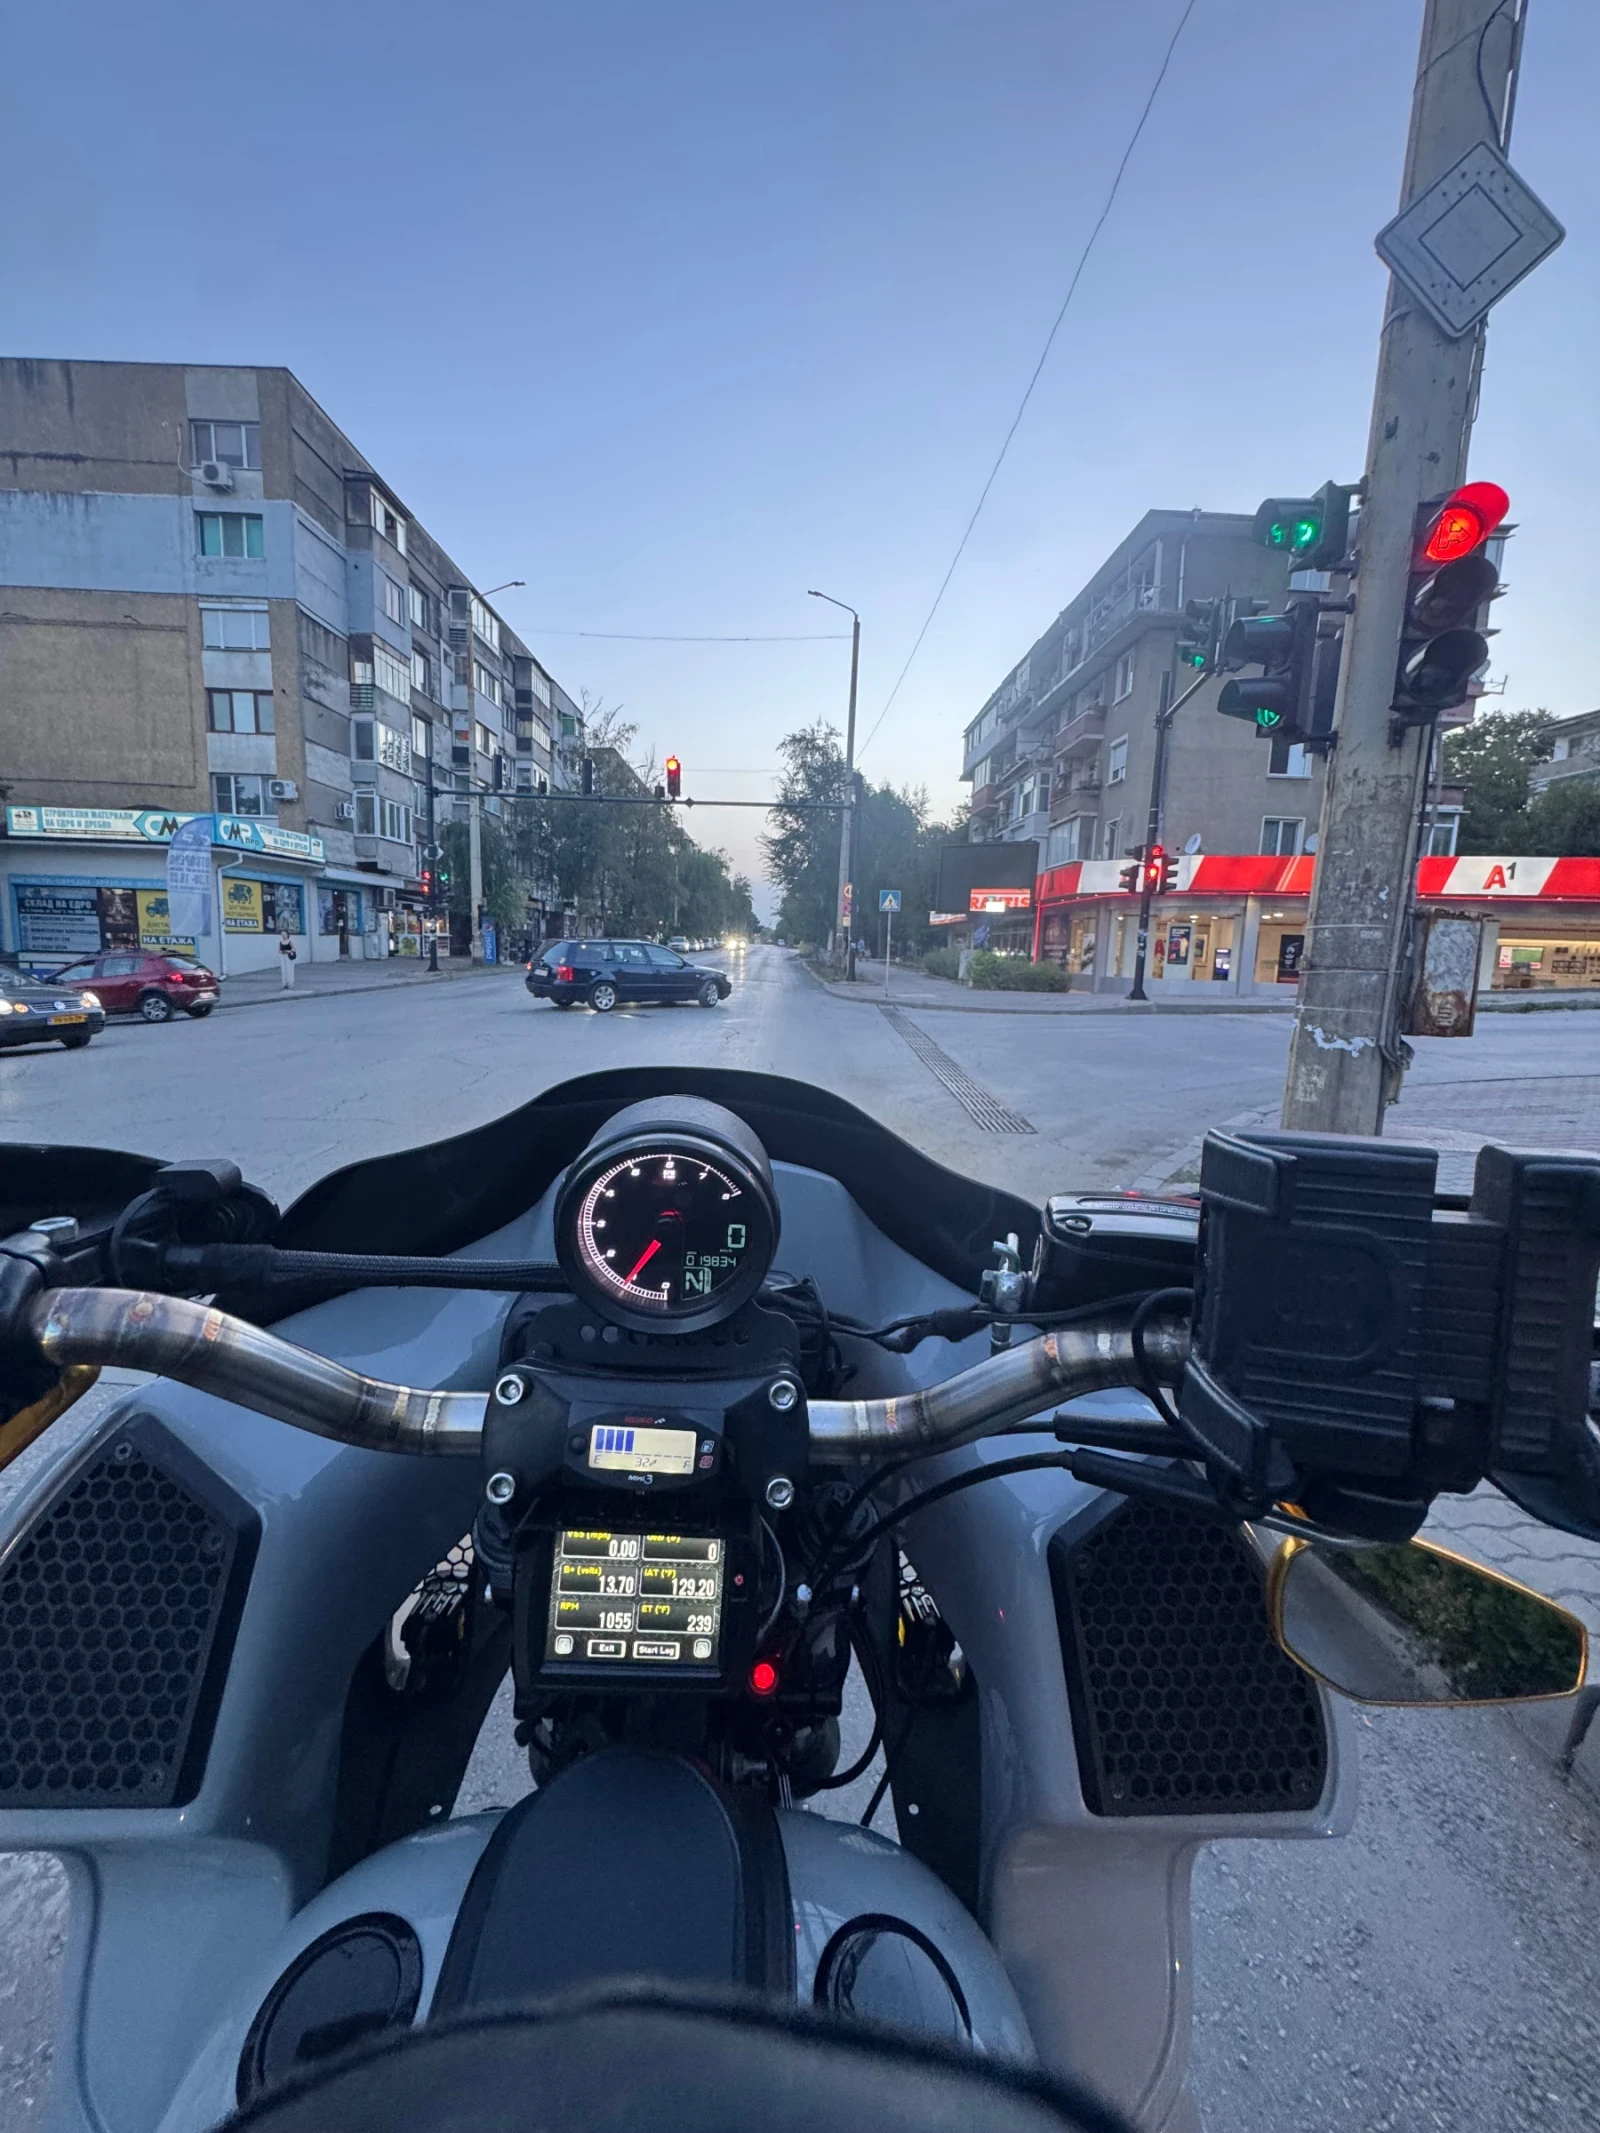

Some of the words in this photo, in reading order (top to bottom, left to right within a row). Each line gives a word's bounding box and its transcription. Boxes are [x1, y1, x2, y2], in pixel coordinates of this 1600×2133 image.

[245, 837, 260, 846] ПРО
[24, 899, 54, 909] СКЛАД
[55, 899, 67, 909] НА
[69, 900, 92, 909] ЕДРО
[226, 919, 236, 927] НА
[236, 920, 258, 928] ЕТАЖА
[143, 936, 158, 944] НА
[160, 937, 194, 945] ЕТАЖА
[605, 1189, 615, 1199] 4
[728, 1224, 746, 1248] 0
[685, 1269, 704, 1293] N
[594, 1455, 602, 1464] E
[683, 1460, 692, 1469] F
[608, 1539, 637, 1558] 0.00
[708, 1543, 717, 1560] 0
[576, 1566, 603, 1577] (volts)
[599, 1575, 634, 1594] 13.70
[671, 1577, 715, 1597] 129.20
[560, 1602, 580, 1611] RPM
[641, 1604, 653, 1613] ET
[599, 1612, 632, 1630] 1055
[687, 1615, 712, 1632] 239
[599, 1644, 615, 1653] Exit
[638, 1646, 658, 1655] Start
[659, 1646, 675, 1656] Log
